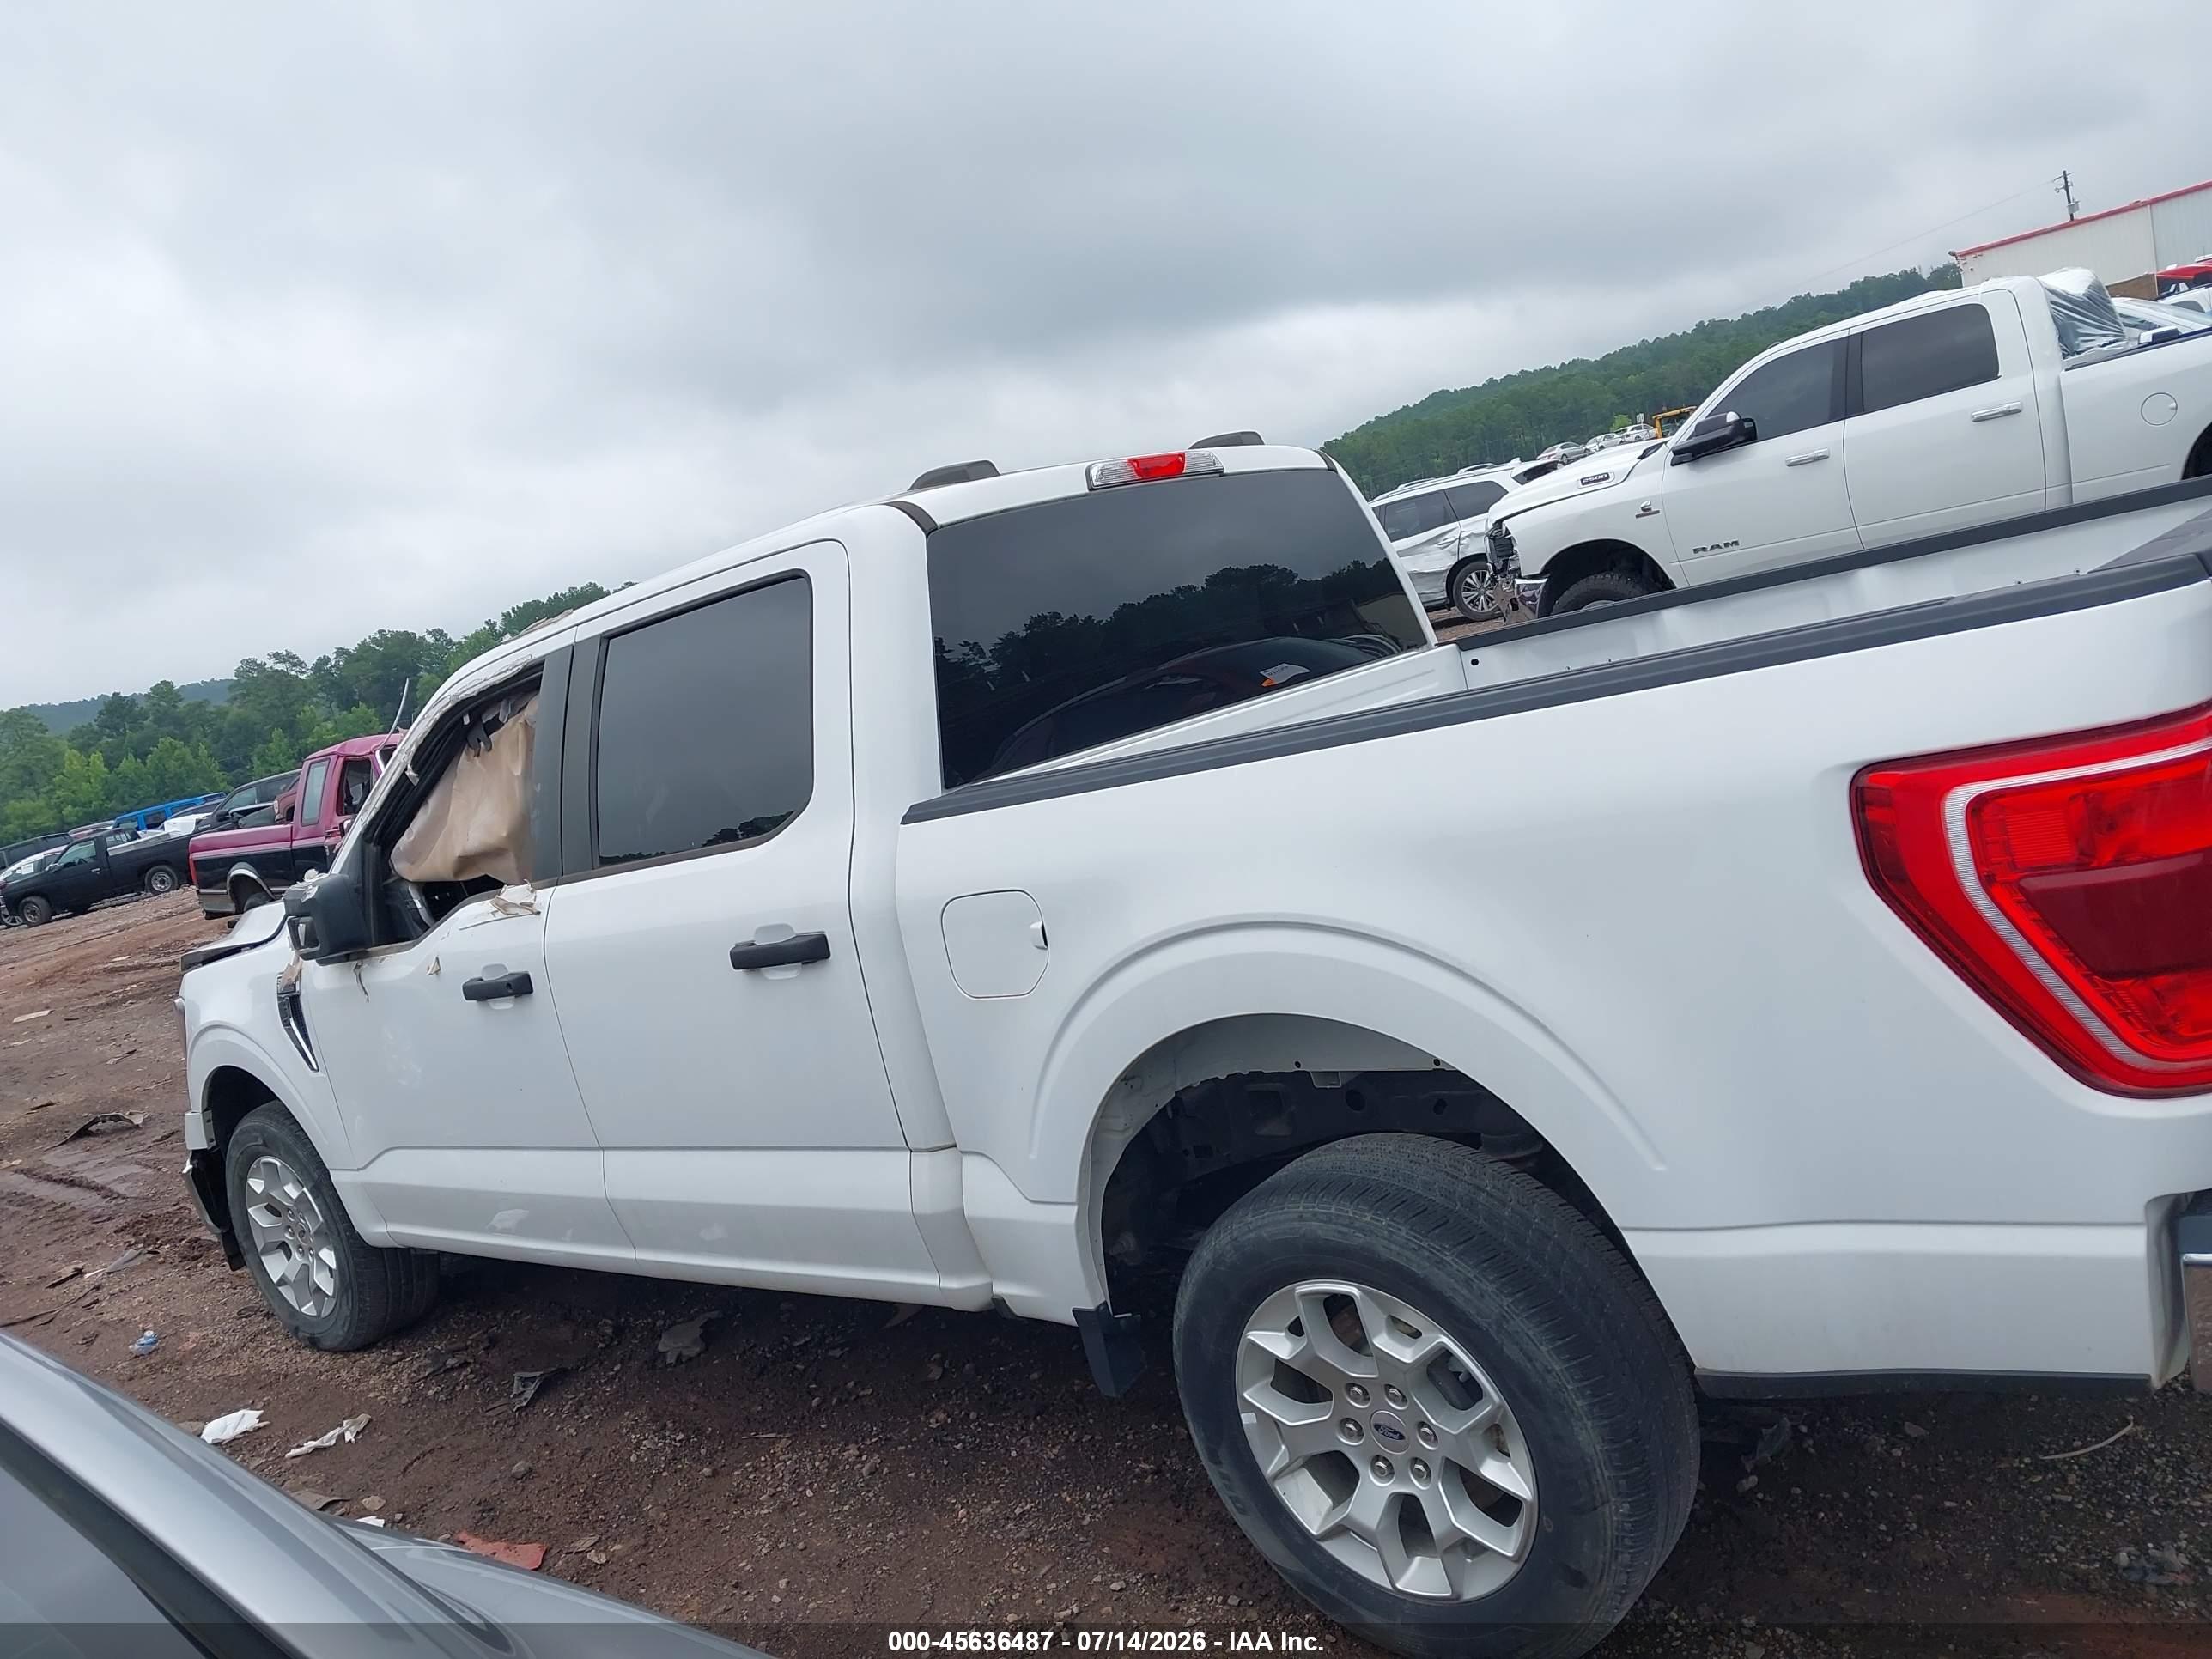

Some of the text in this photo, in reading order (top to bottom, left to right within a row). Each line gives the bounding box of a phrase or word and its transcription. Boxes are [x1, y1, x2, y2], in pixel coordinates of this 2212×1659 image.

[1582, 473, 1608, 483] 2500
[1692, 539, 1741, 555] RAM
[1377, 1425, 1401, 1440] Ford
